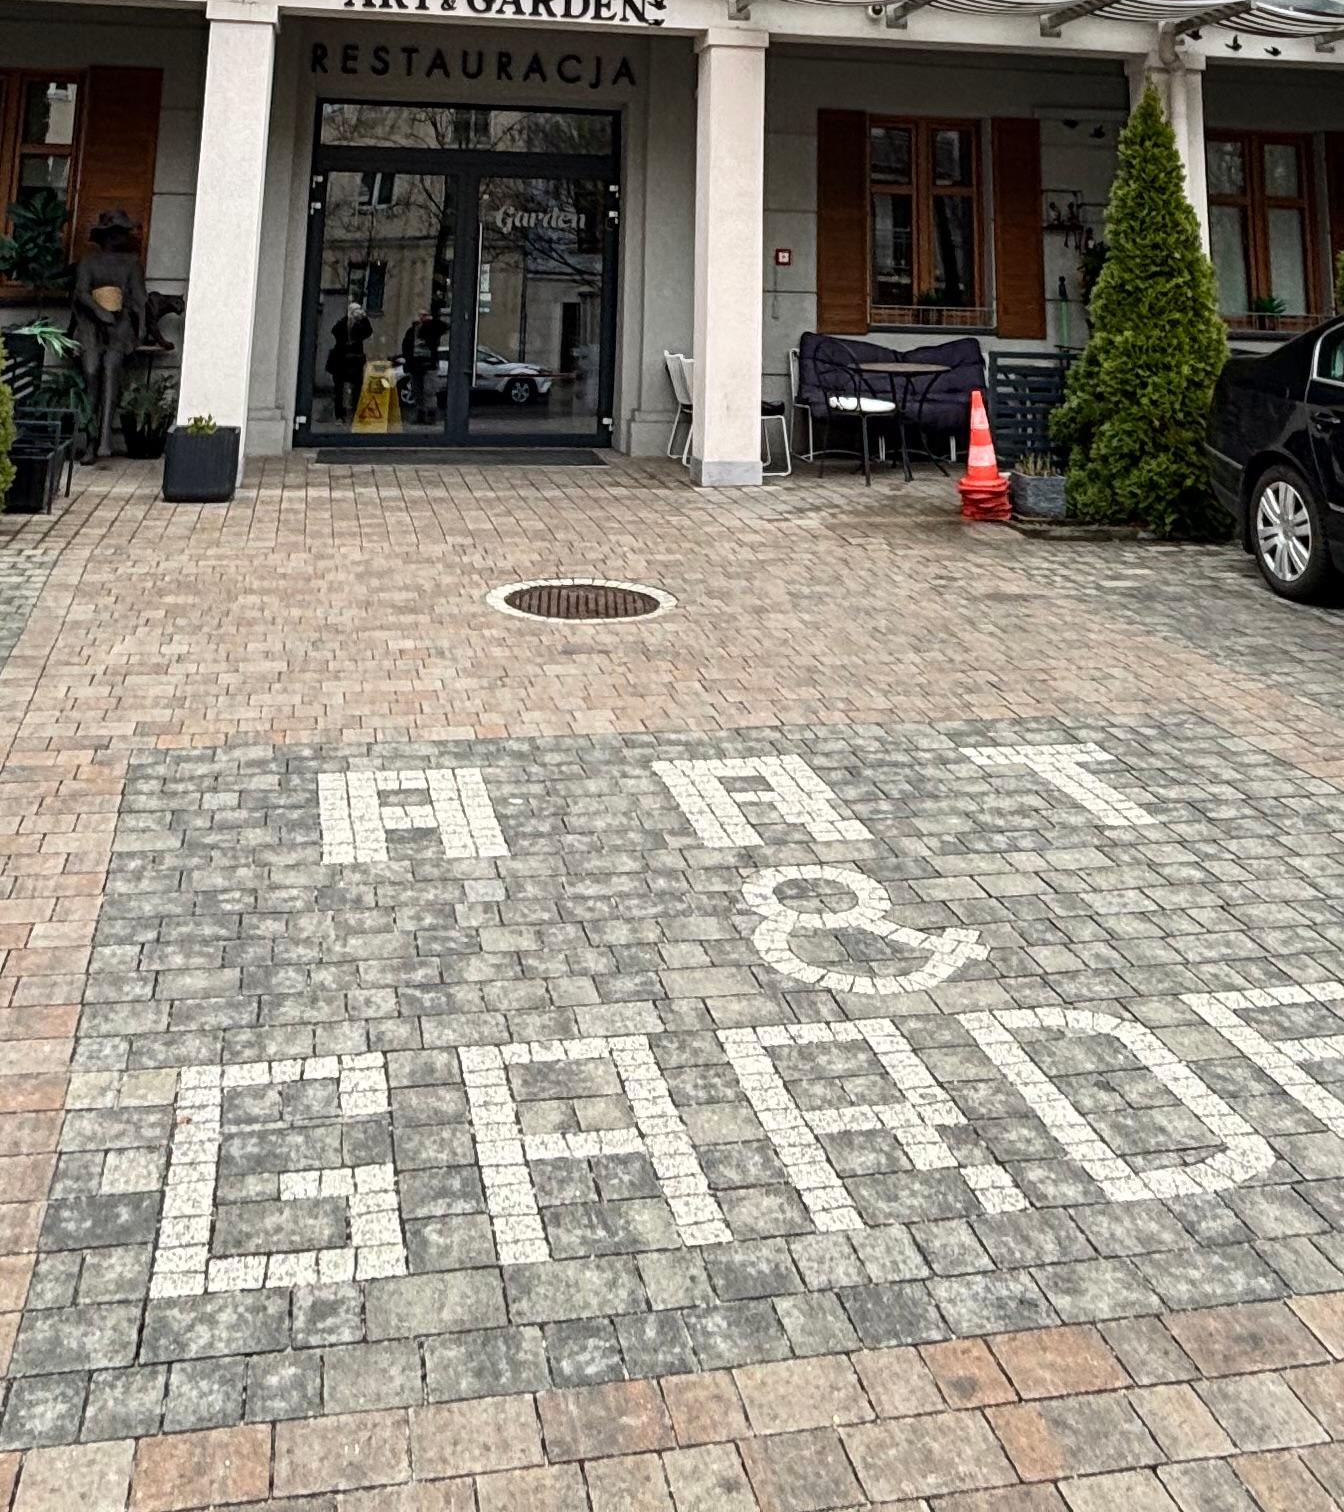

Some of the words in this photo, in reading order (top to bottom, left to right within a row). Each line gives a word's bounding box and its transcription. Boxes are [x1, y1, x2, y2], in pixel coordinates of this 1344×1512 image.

[311, 43, 637, 90] RESTAURACJA
[495, 205, 586, 234] Garden
[320, 742, 1159, 864] ART
[741, 864, 991, 996] &
